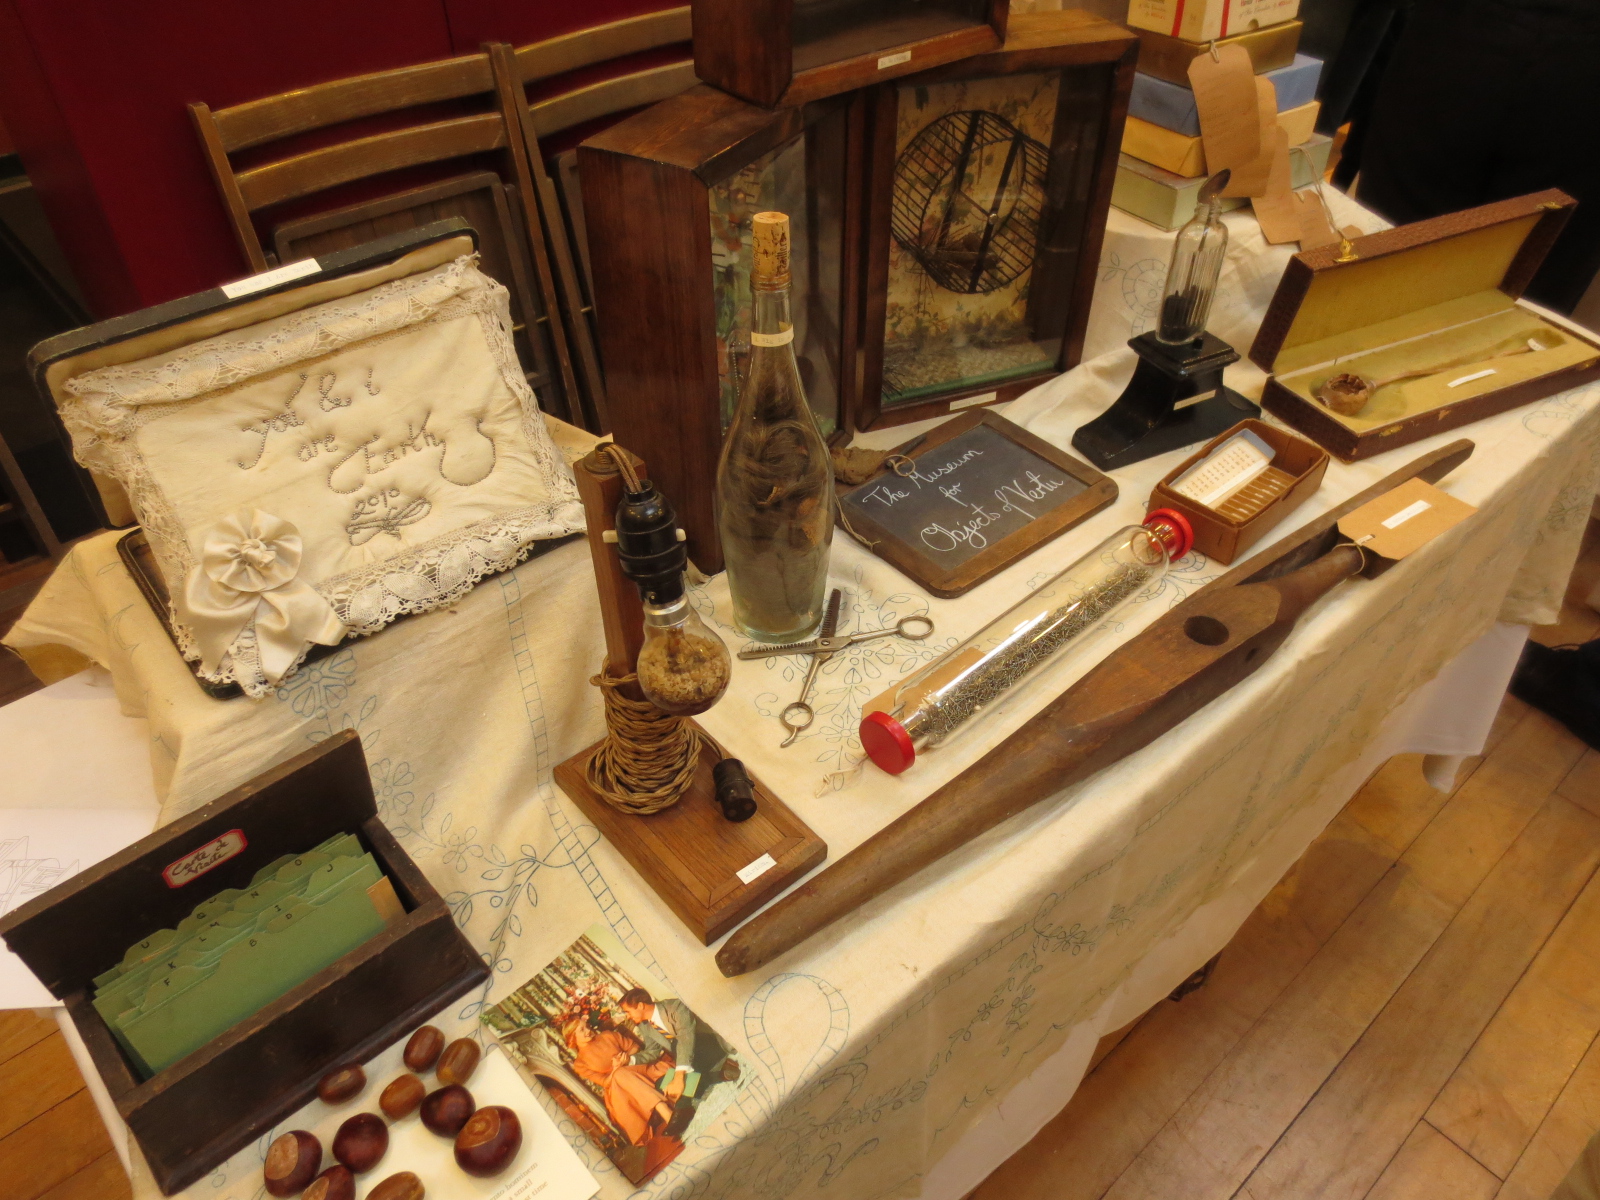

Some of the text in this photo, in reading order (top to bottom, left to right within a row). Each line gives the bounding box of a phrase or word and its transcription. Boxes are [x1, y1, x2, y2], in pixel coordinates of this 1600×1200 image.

[327, 410, 454, 495] Earth
[862, 449, 984, 507] The Museum
[938, 482, 968, 507] for
[920, 470, 1064, 551] Objects of Vertu
[172, 839, 229, 876] Carte de
[513, 1178, 534, 1198] small
[531, 1181, 549, 1196] time
